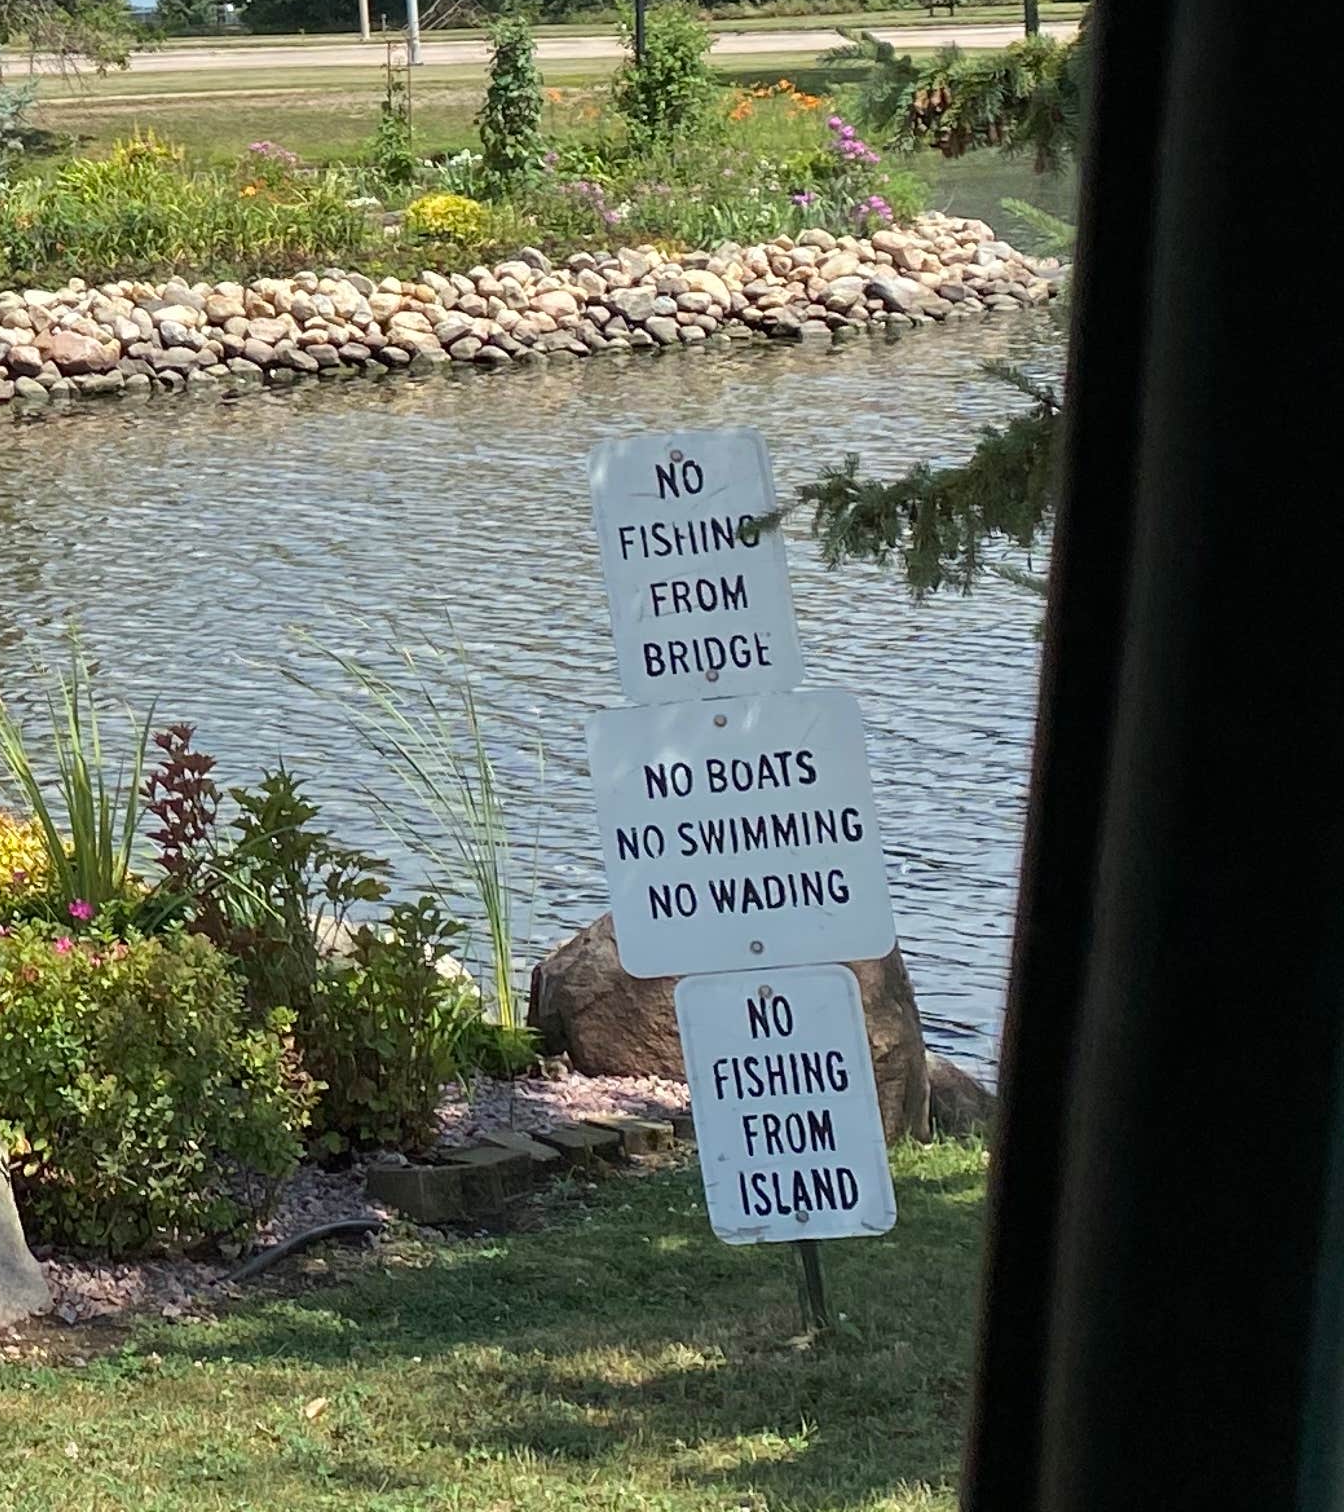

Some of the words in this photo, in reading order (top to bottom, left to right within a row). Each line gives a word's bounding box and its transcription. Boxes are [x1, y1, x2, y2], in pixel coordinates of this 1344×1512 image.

[655, 459, 704, 500] NO
[650, 574, 749, 617] FROM
[643, 632, 773, 677] BRIDGE
[643, 762, 694, 800] NO
[706, 750, 818, 794] BOATS
[616, 824, 665, 861] NO
[677, 807, 864, 858] SWIMMING
[648, 883, 698, 920] NO
[708, 869, 850, 914] WADING
[747, 995, 793, 1039] NO
[713, 1051, 849, 1100] FISHING
[742, 1110, 836, 1156] FROM
[738, 1168, 859, 1217] ISLAND
